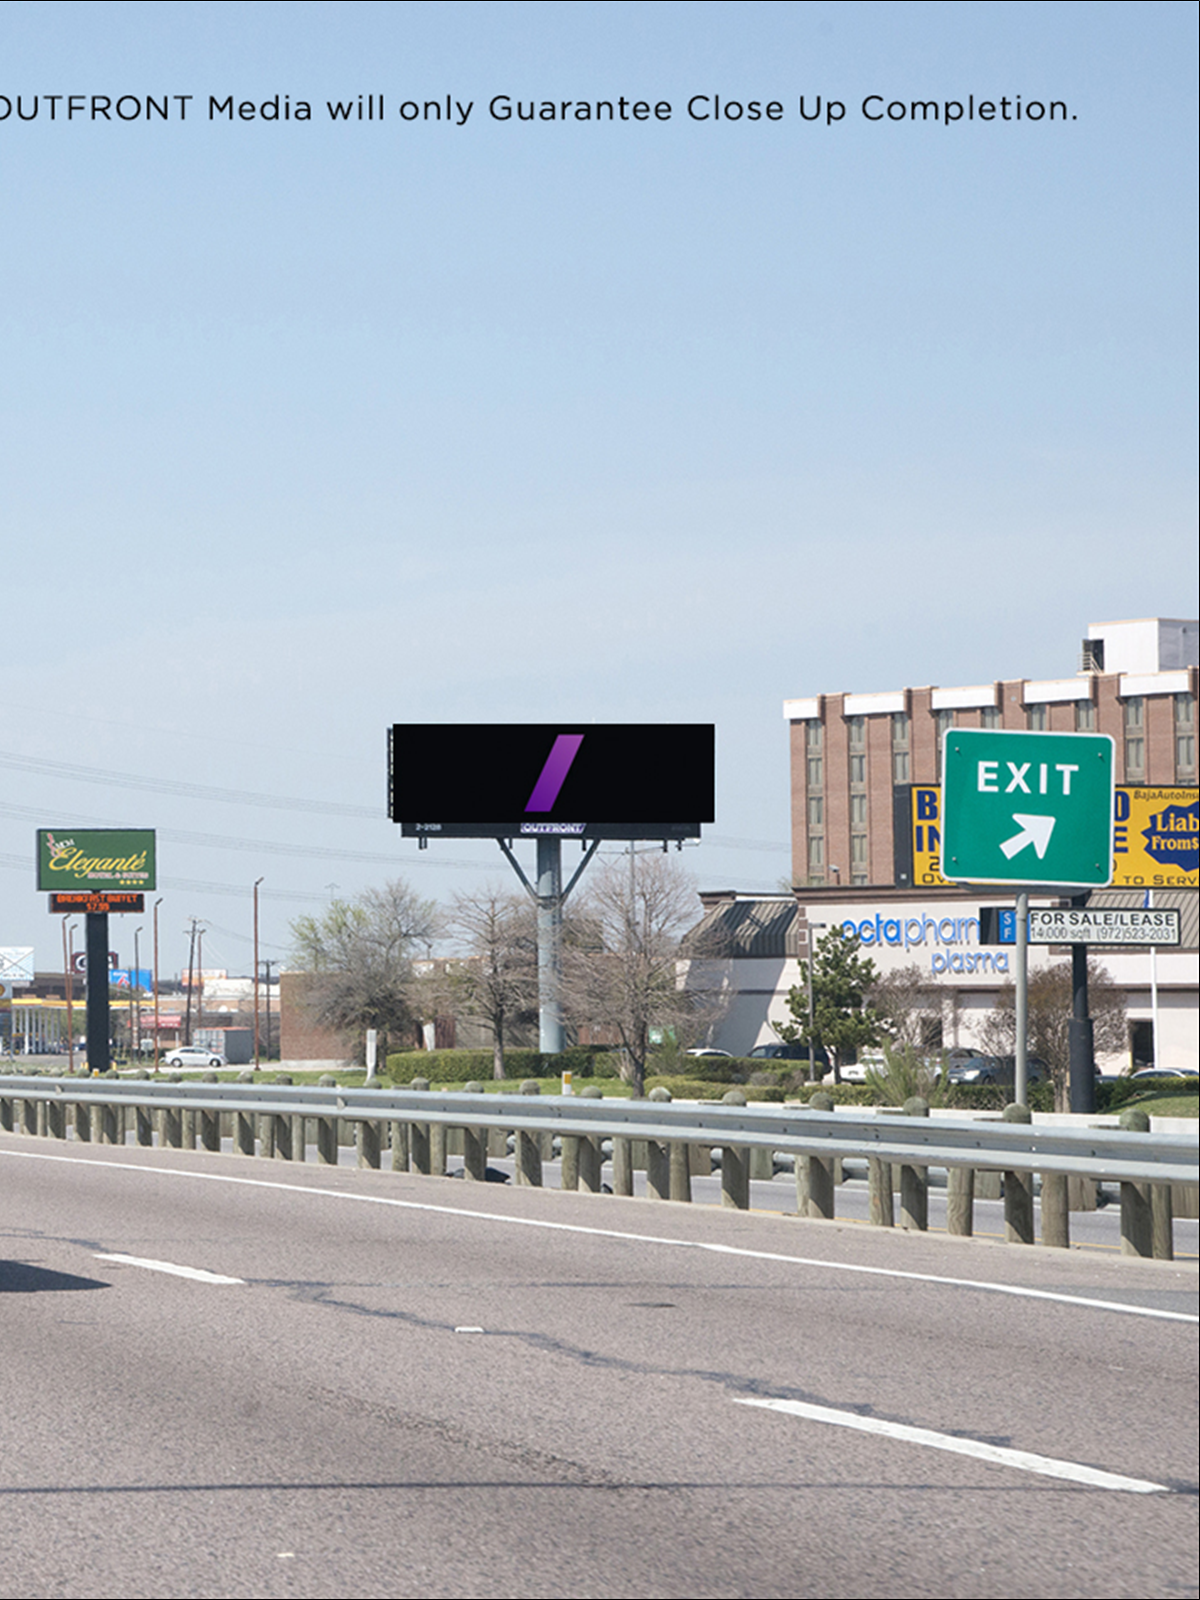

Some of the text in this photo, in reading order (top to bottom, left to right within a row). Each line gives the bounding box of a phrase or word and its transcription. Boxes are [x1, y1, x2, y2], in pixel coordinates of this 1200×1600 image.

[976, 760, 1080, 796] EXIT
[523, 822, 583, 833] OUTFRONT
[48, 846, 147, 879] Eleganté
[1030, 912, 1175, 927] FOR SALE/LEASE
[931, 948, 1009, 975] plasma
